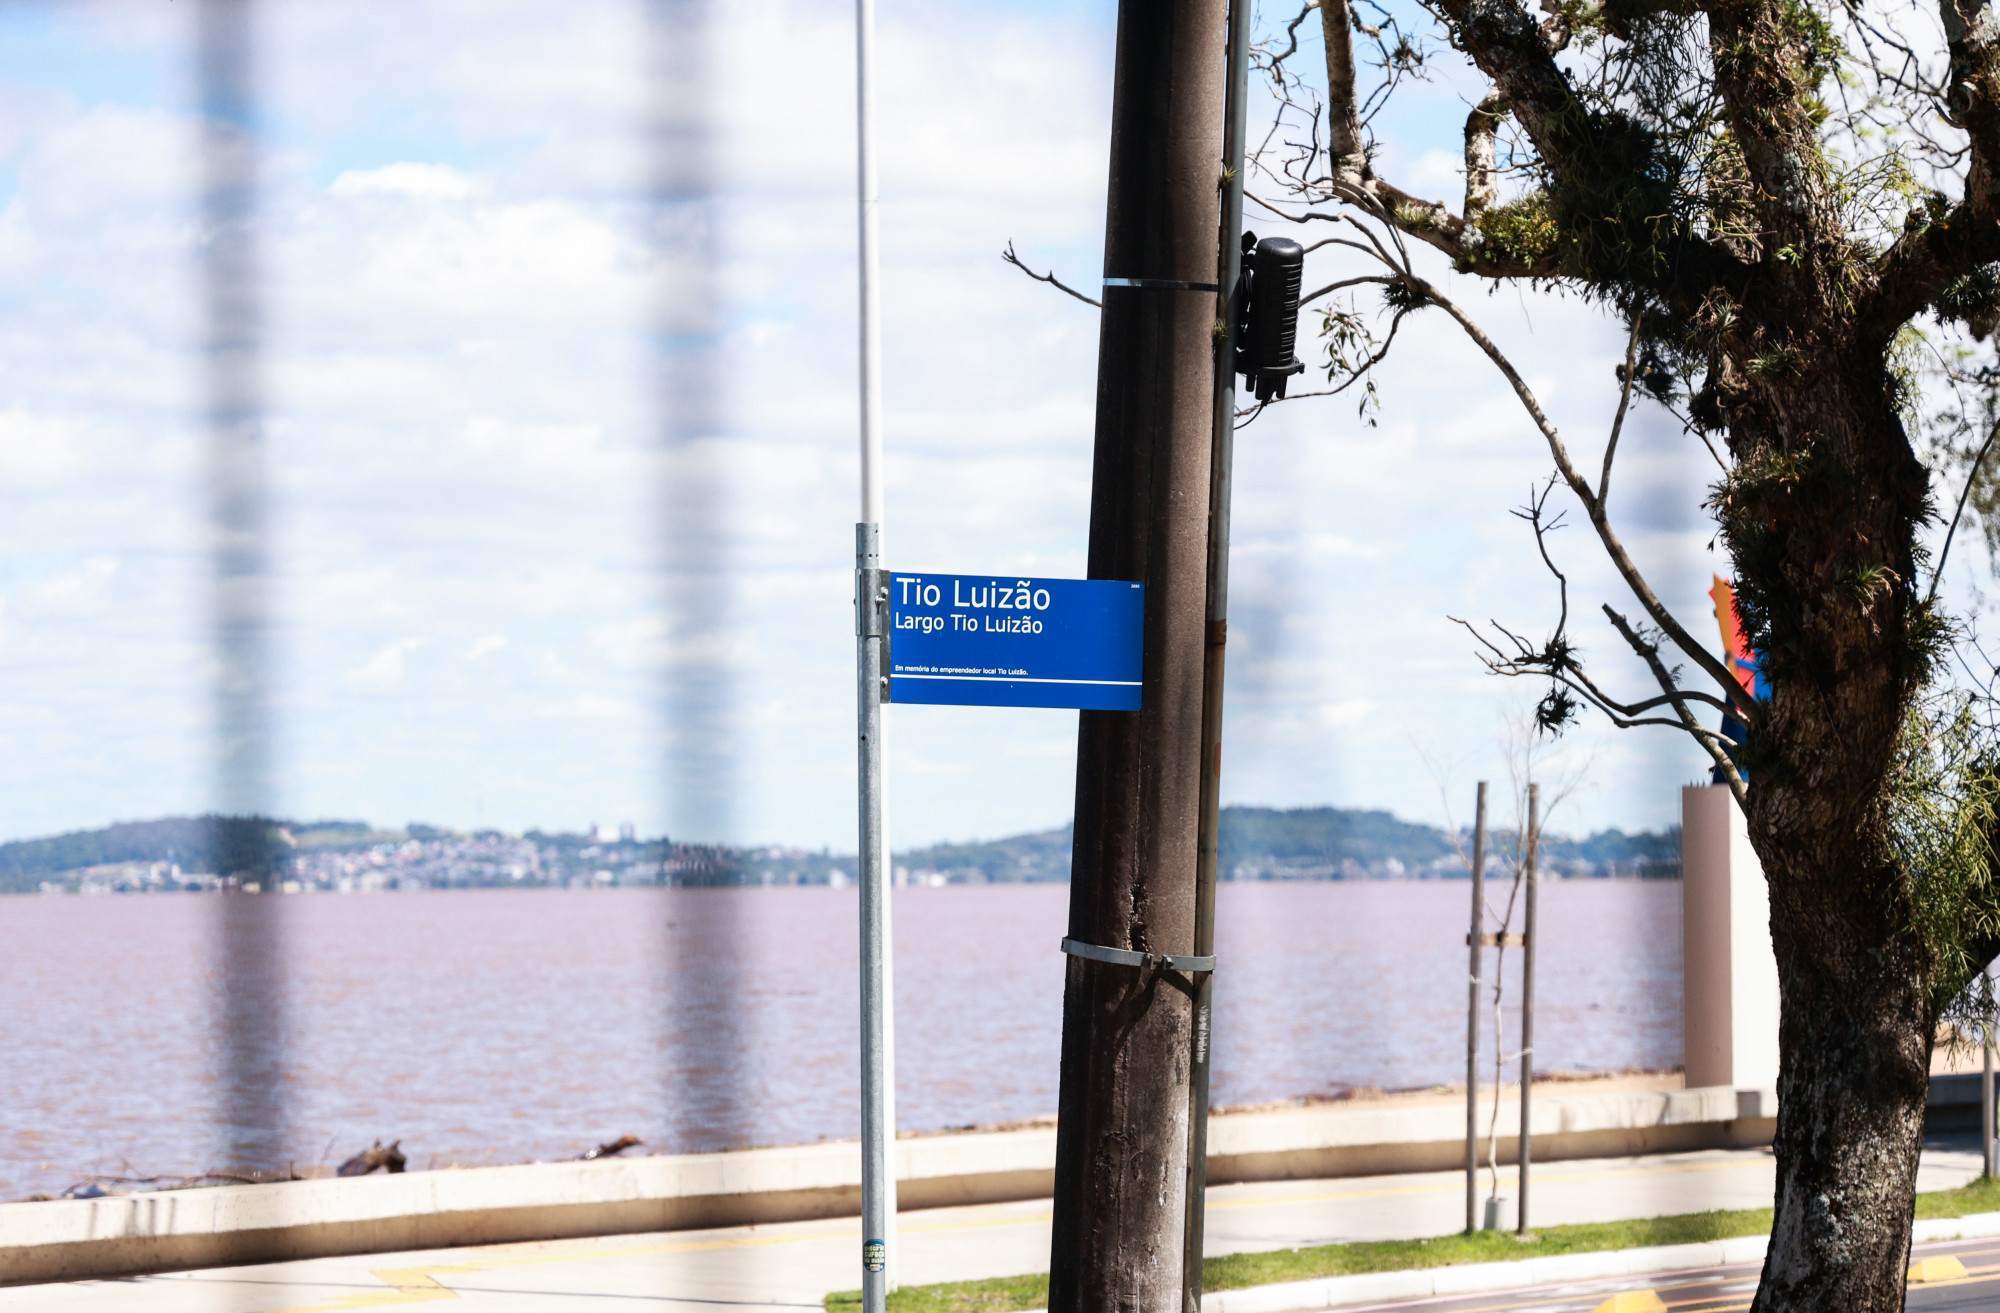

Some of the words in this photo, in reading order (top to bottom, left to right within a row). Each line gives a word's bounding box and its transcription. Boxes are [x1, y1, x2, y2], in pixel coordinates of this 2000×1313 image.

[896, 577, 941, 607] Tio
[954, 580, 1051, 611] Luizão
[895, 612, 944, 634] Largo
[950, 614, 978, 632] Tio
[985, 615, 1043, 634] Luizão
[905, 665, 929, 673] memória
[940, 666, 981, 675] empreendedor
